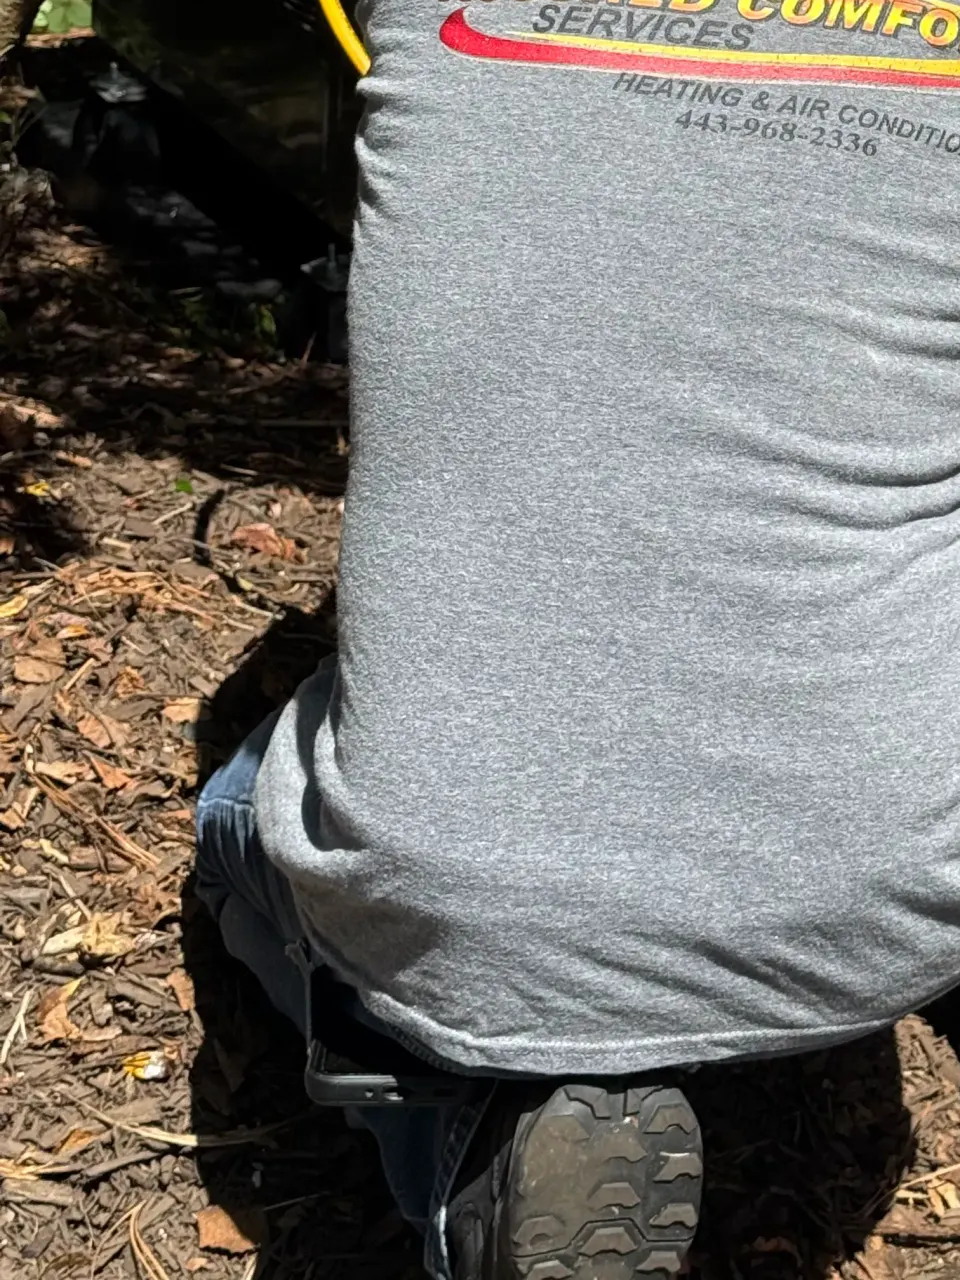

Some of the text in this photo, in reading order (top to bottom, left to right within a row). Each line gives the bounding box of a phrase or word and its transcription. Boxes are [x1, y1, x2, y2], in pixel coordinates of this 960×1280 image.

[532, 5, 755, 52] SERVICES
[613, 72, 741, 109] HEATING
[751, 91, 774, 112] &
[779, 94, 831, 120] AIR
[676, 109, 878, 158] 443-968-2336
